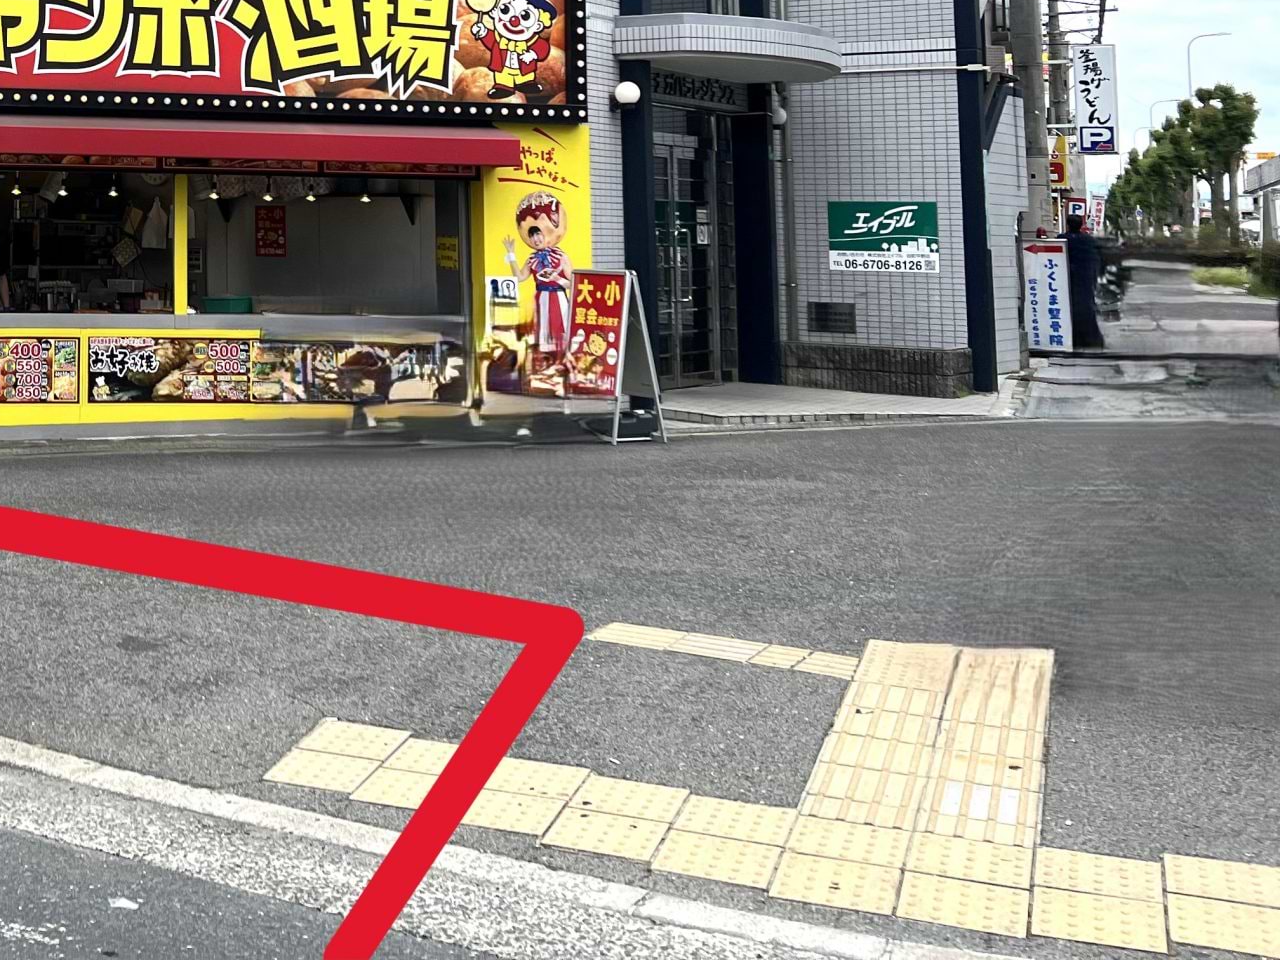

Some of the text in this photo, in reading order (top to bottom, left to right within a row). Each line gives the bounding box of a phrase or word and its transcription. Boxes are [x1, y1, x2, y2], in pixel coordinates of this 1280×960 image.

[1082, 128, 1112, 148] P
[843, 205, 919, 235] エイブル
[844, 259, 923, 271] 06-6706-8126
[9, 342, 42, 358] 400
[208, 343, 241, 359] 500
[16, 360, 42, 372] 550
[90, 345, 159, 377] お好み焼
[216, 361, 240, 373] 500
[16, 373, 42, 385] 700
[16, 386, 42, 399] 850
